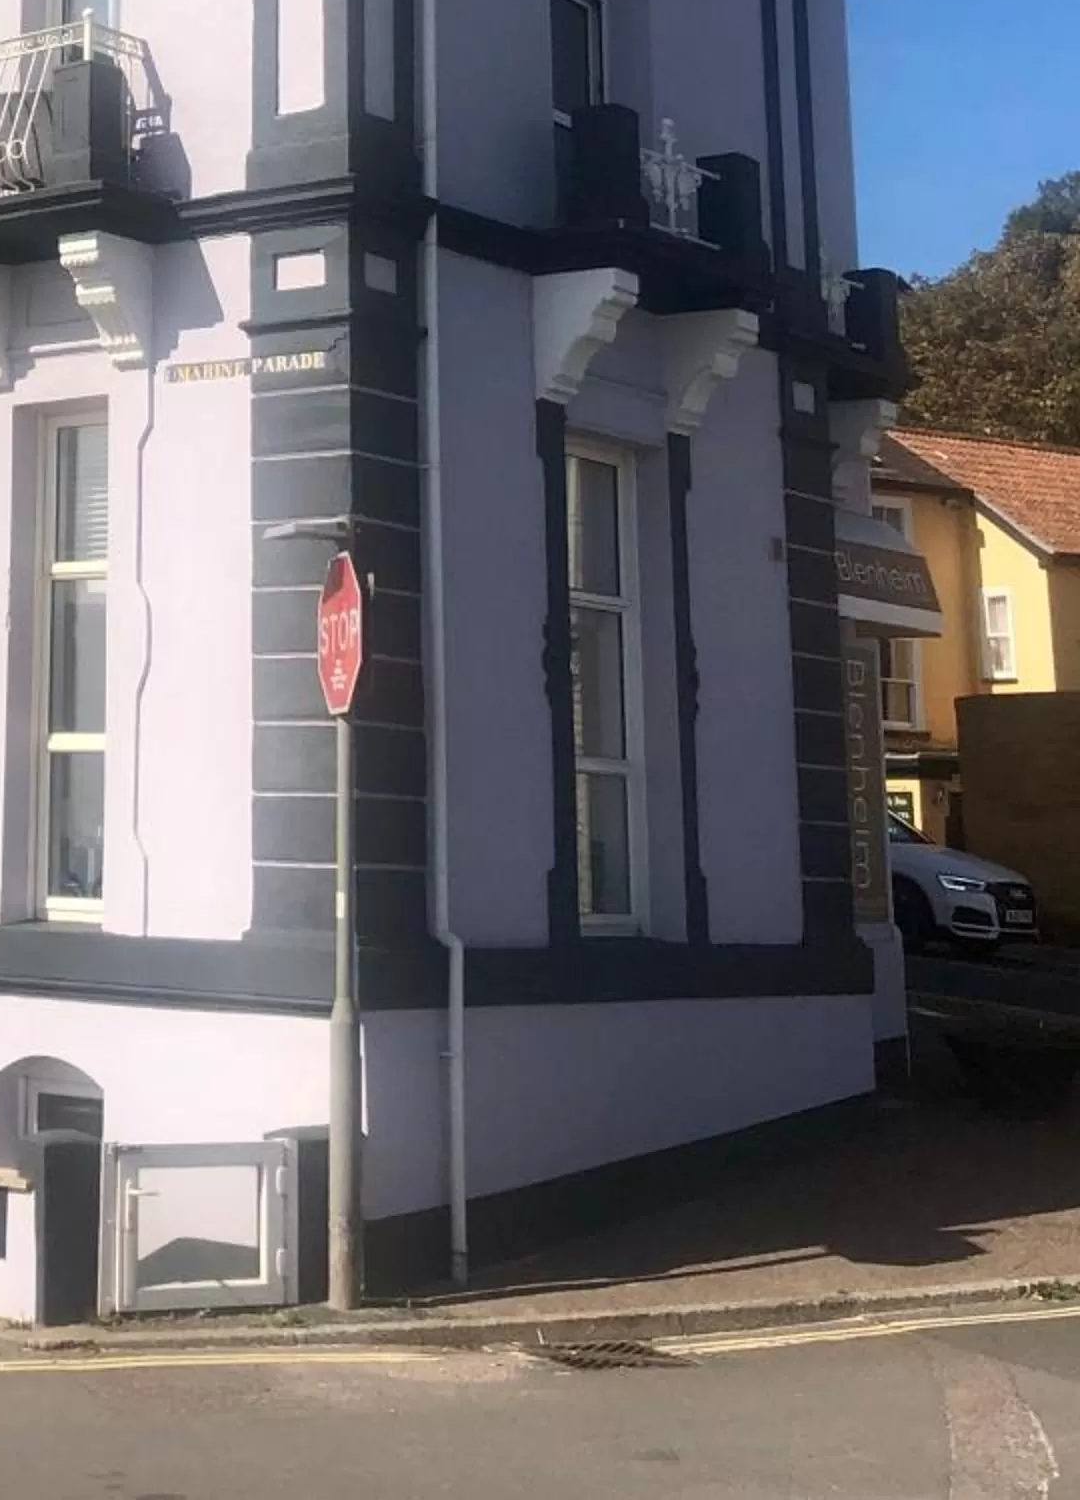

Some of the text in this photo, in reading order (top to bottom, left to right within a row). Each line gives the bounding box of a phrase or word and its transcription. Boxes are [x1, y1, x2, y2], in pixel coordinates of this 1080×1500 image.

[252, 351, 325, 373] PARADE
[321, 609, 358, 656] STOP
[846, 660, 872, 890] Blenheim
